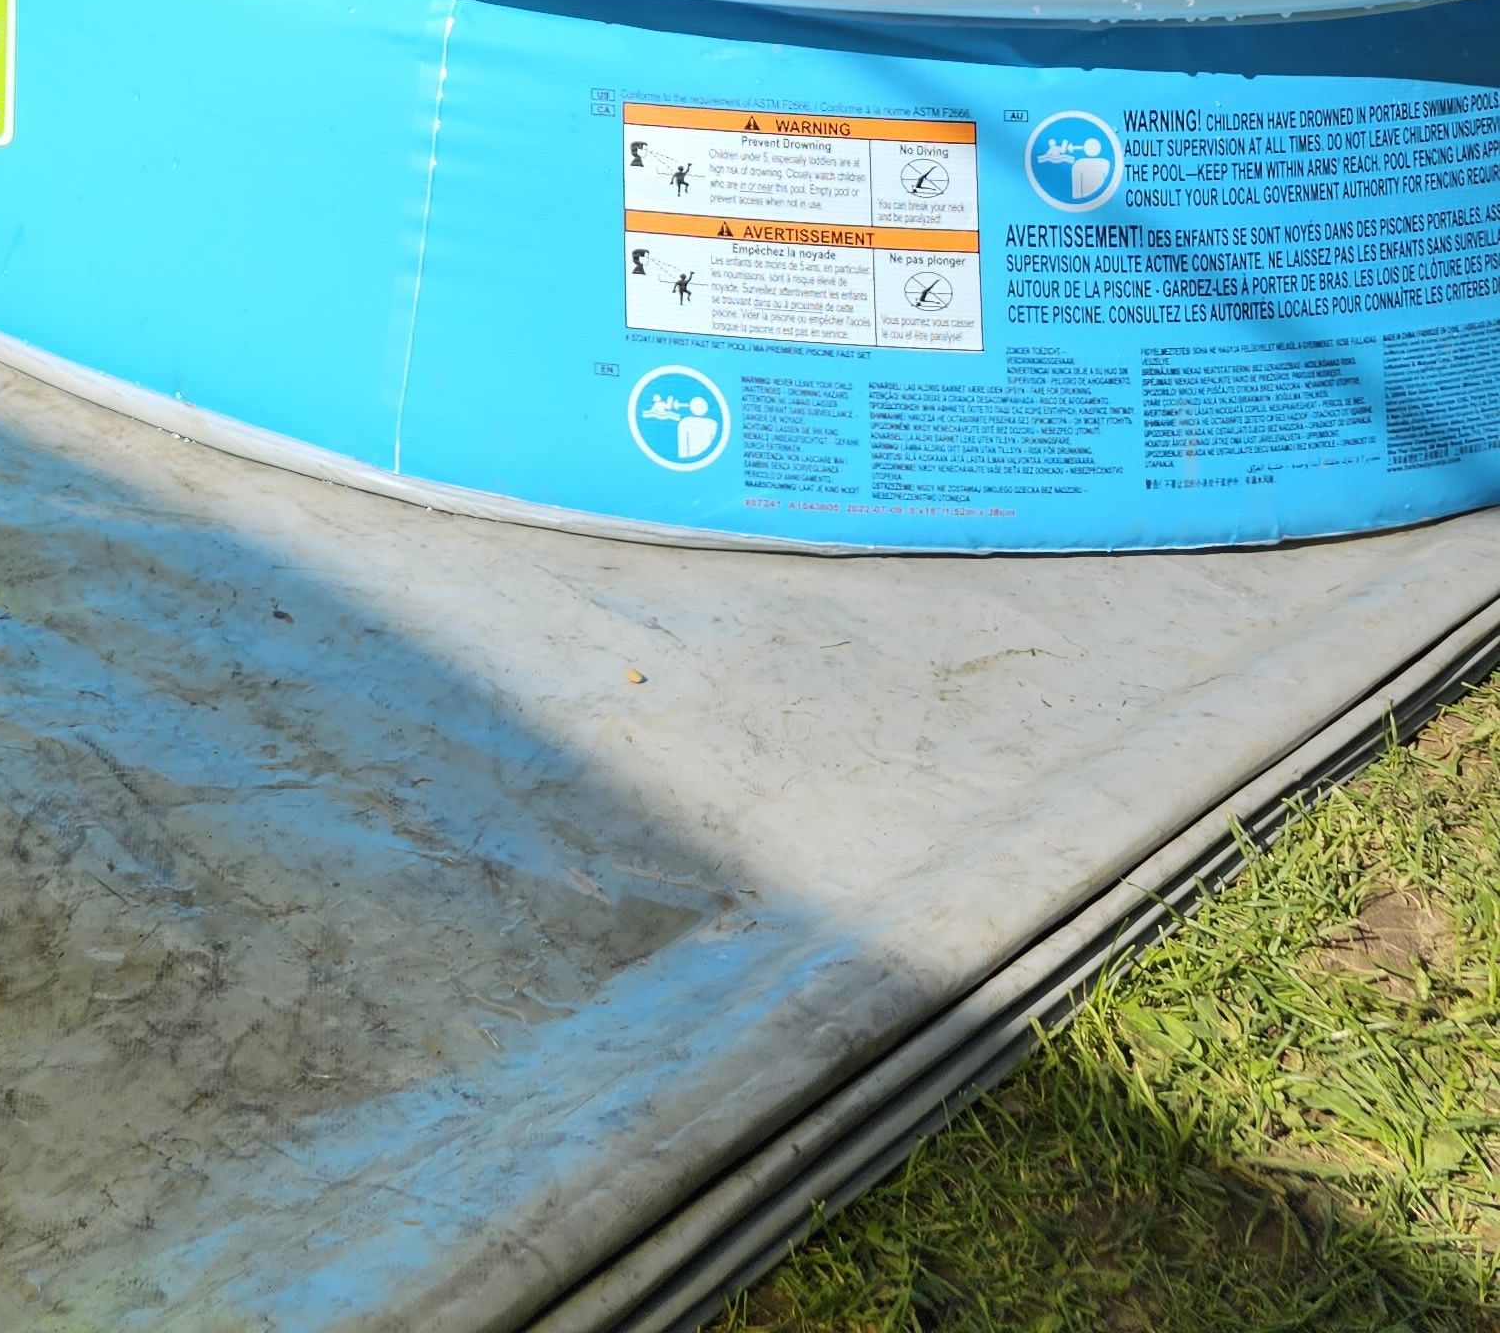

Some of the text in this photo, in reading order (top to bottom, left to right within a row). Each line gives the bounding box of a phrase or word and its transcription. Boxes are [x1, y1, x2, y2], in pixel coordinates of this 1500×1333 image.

[754, 98, 779, 109] ASTM
[913, 107, 940, 117] ASTM
[1010, 112, 1024, 120] AU
[1124, 110, 1201, 132] WARNING!
[1207, 113, 1263, 131] CHILDREN
[1268, 111, 1296, 129] HAVE
[1300, 108, 1353, 128] DROWNED
[1357, 107, 1366, 124] IN
[1369, 102, 1420, 123] PORTABLE
[1423, 96, 1468, 118] SWIMMING
[776, 119, 850, 136] WARNING
[742, 135, 832, 153] Prevent Drowning
[1125, 139, 1163, 157] ADULT
[1167, 138, 1245, 156] SUPERVISION
[1249, 137, 1262, 154] AT
[1265, 137, 1286, 154] ALL
[1289, 134, 1324, 152] TIMES.
[1327, 133, 1342, 150] DO
[1345, 131, 1366, 149] NOT
[1369, 128, 1400, 147] LEAVE
[1403, 123, 1449, 144] CHILDREN
[709, 148, 739, 161] Children
[741, 152, 761, 162] under
[771, 154, 806, 167] especially
[809, 154, 837, 167] toddlers
[840, 159, 851, 167] are
[900, 145, 949, 159] No Diving
[1125, 164, 1148, 181] THE
[1231, 162, 1262, 180] THEM
[1266, 160, 1304, 179] WITHIN
[1343, 155, 1381, 173] REACH.
[1384, 152, 1411, 170] POOL
[1413, 146, 1453, 167] FENCING
[1456, 143, 1480, 162] LAWS
[1126, 189, 1181, 207] CONSULT
[1185, 188, 1218, 206] YOUR
[1222, 187, 1260, 205] LOCAL
[1264, 182, 1339, 203] GOVERNMENT
[1343, 177, 1399, 198] AUTHORITY
[1403, 175, 1422, 193] FOR
[1425, 169, 1464, 190] FENCING
[878, 199, 891, 210] You
[908, 200, 929, 211] break
[930, 204, 947, 213] your
[948, 202, 964, 213] neck
[878, 212, 891, 222] and
[893, 213, 903, 222] be
[743, 226, 874, 246] AVERTISSEMENT
[1006, 225, 1143, 247] AVERTISSEMENT!
[1148, 230, 1171, 247] DES
[1175, 229, 1228, 247] ENFANTS
[1233, 228, 1247, 245] SE
[1251, 226, 1280, 244] SONT
[1285, 222, 1321, 243] NOYÉS
[1325, 221, 1353, 240] DANS
[1357, 219, 1377, 238] DES
[1380, 214, 1424, 235] PISCINES
[1427, 207, 1482, 229] PORTABLES.
[732, 243, 836, 261] Empêchez la noyade
[889, 253, 966, 268] Ne pas plonger
[1007, 254, 1091, 273] SUPERVISION
[1094, 255, 1143, 273] ADULTE
[1145, 254, 1189, 272] ACTIVE
[1192, 252, 1265, 272] CONSTANTE.
[1269, 251, 1283, 268] NE
[1287, 248, 1332, 267] LAISSEZ
[1335, 246, 1355, 264] PAS
[1358, 244, 1377, 262] LES
[1380, 239, 1424, 260] ENFANTS
[1428, 235, 1453, 255] SANS
[1007, 279, 1060, 298] AUTOUR
[1065, 281, 1080, 298] DE
[1085, 281, 1100, 298] LA
[1104, 280, 1152, 298] PISCINE
[1163, 278, 1238, 297] GARDEZ-LES
[1253, 275, 1298, 294] PORTER
[1301, 274, 1316, 291] DE
[1319, 271, 1351, 290] BRAS.
[1354, 269, 1374, 287] LES
[1377, 266, 1399, 285] LOIS
[1402, 264, 1415, 282] DE
[1465, 255, 1482, 274] DES
[1009, 305, 1048, 323] CETTE
[1053, 306, 1104, 323] PISCINE.
[1109, 305, 1180, 323] CONSULTEZ
[1185, 304, 1206, 322] LES
[1211, 298, 1274, 321] AUTORITÉS
[1278, 297, 1328, 318] LOCALES
[1332, 295, 1361, 313] POUR
[1425, 286, 1443, 304] LES
[857, 351, 871, 359] SET
